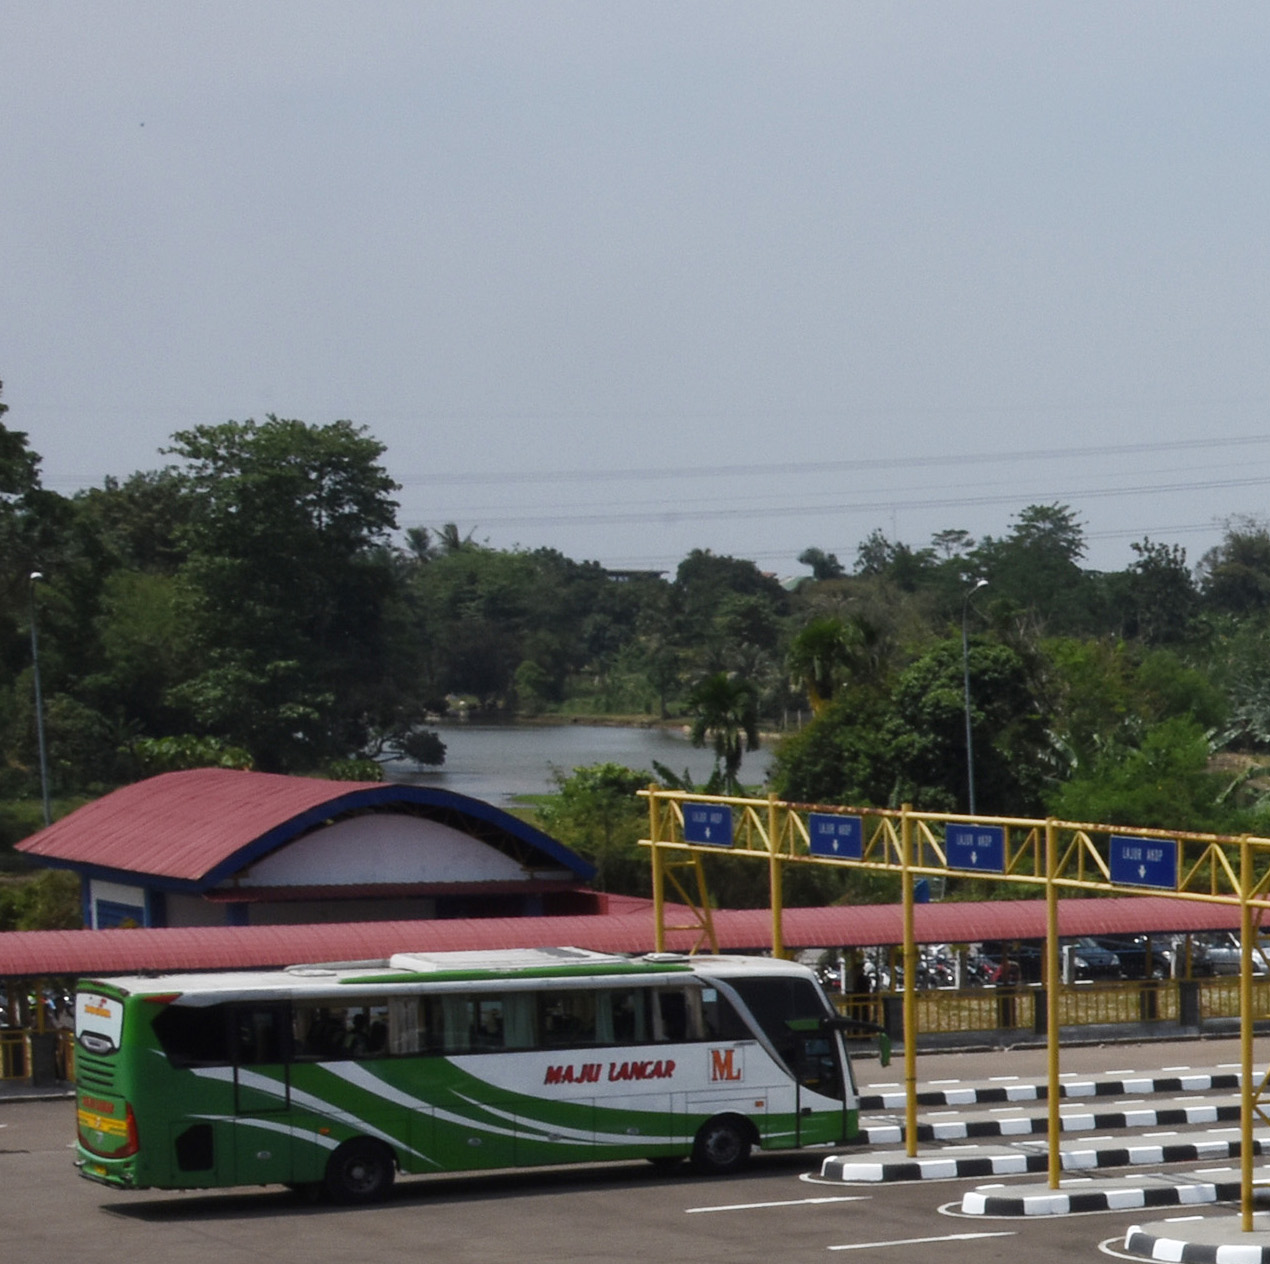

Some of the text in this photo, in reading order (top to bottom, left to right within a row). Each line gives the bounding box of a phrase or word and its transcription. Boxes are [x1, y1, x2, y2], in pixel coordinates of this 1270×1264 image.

[544, 1059, 676, 1085] MAJU LANCAR
[711, 1049, 741, 1081] ML
